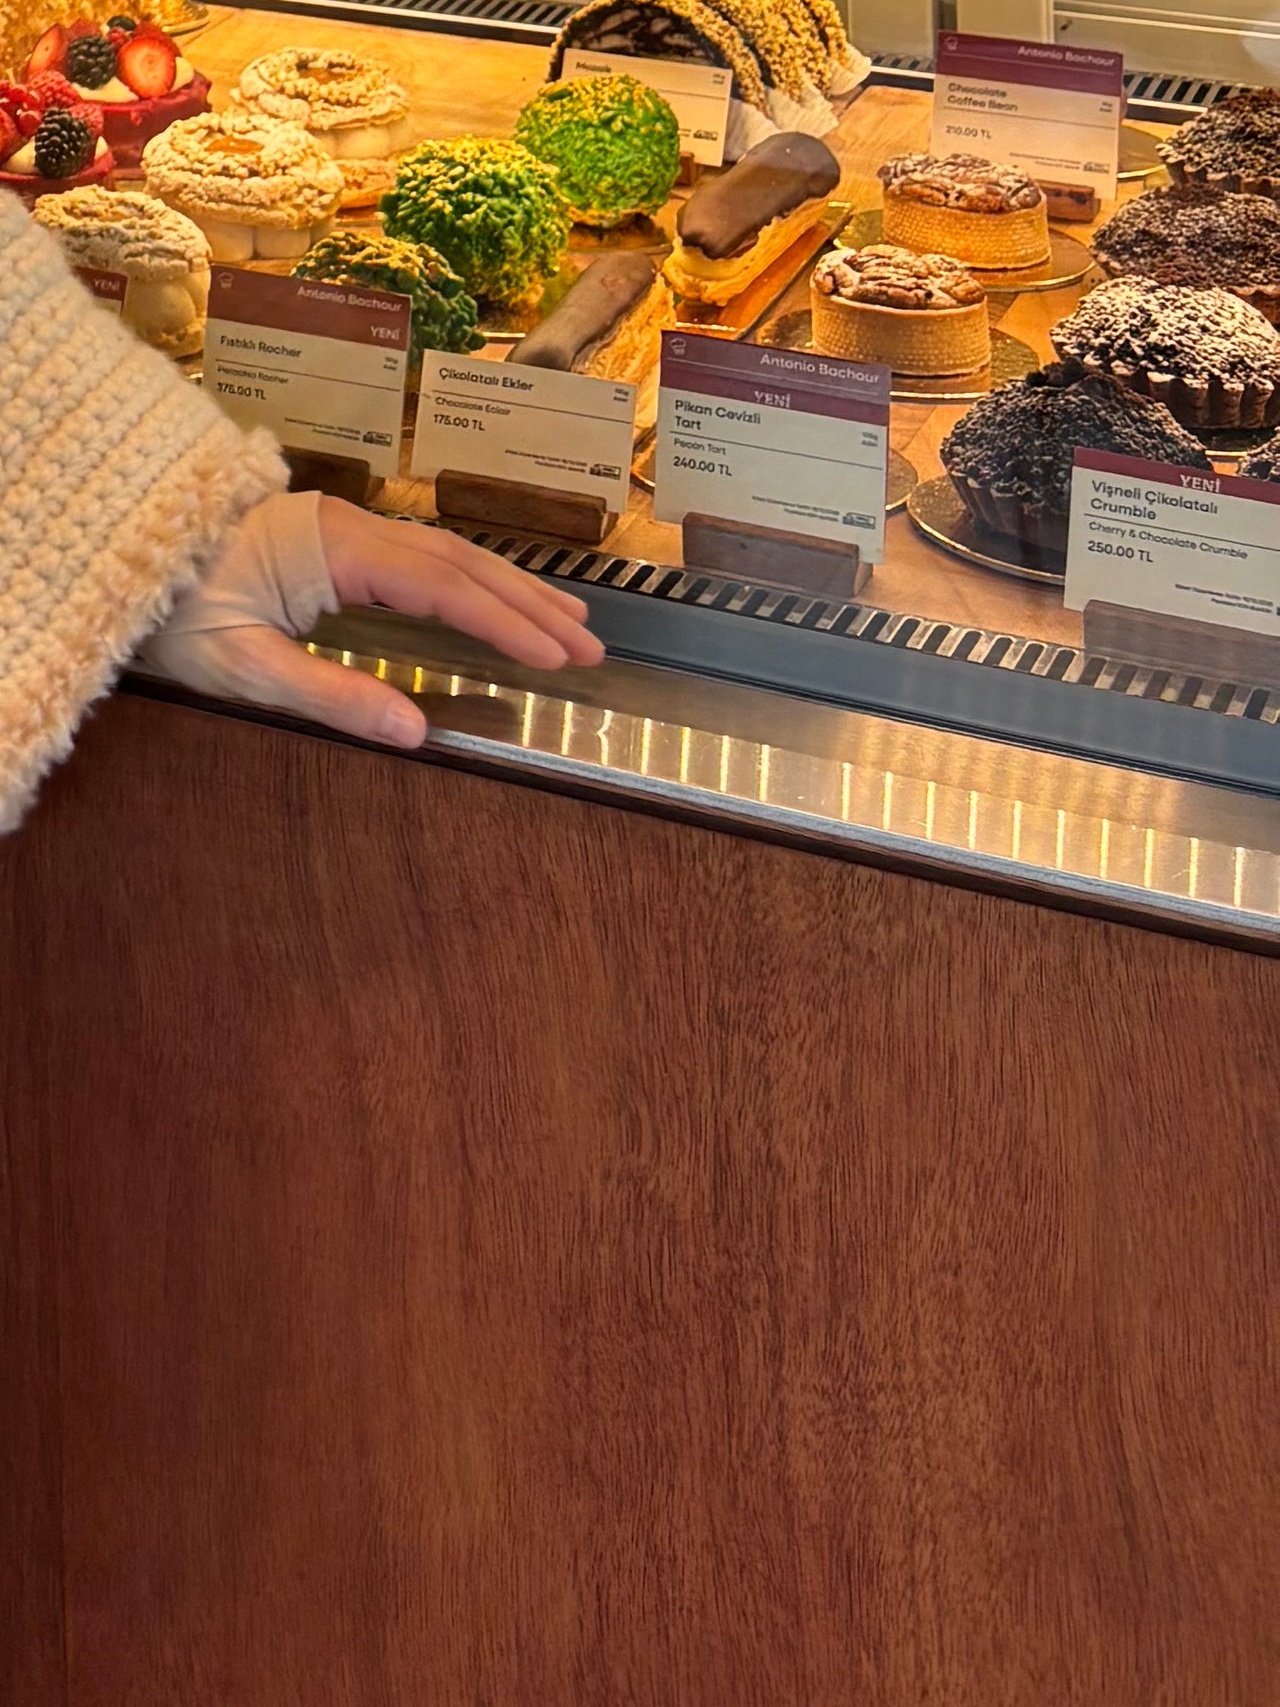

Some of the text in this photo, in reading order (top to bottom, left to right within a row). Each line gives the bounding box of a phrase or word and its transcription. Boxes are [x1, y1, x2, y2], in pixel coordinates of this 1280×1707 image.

[1018, 46, 1116, 67] Antonio Bachour
[947, 82, 1008, 98] Chocolate
[947, 94, 1018, 112] Coffee Bean
[980, 130, 992, 140] TL
[297, 286, 402, 312] Antonio Bachour
[371, 325, 401, 341] YENİ
[258, 341, 302, 358] Rocher
[439, 367, 534, 391] Çikolatalı Ekler
[760, 353, 879, 384] Antonio Bachour
[254, 388, 267, 400] TL
[754, 390, 791, 409] YENİ
[675, 399, 761, 424] Pikan Cevizli
[472, 418, 486, 431] TL
[675, 415, 702, 430] Tart
[674, 438, 727, 455] Pecan Tart
[673, 455, 733, 477] 240.00 TL
[1180, 473, 1221, 494] YENİ
[1092, 479, 1218, 514] Vişneli Çikolatalı
[1090, 498, 1157, 520] Crumble
[1089, 521, 1127, 539] Cherry
[1139, 530, 1197, 550] Chocolate
[1199, 542, 1248, 560] Crumble
[1088, 540, 1154, 563] 250.00 TL
